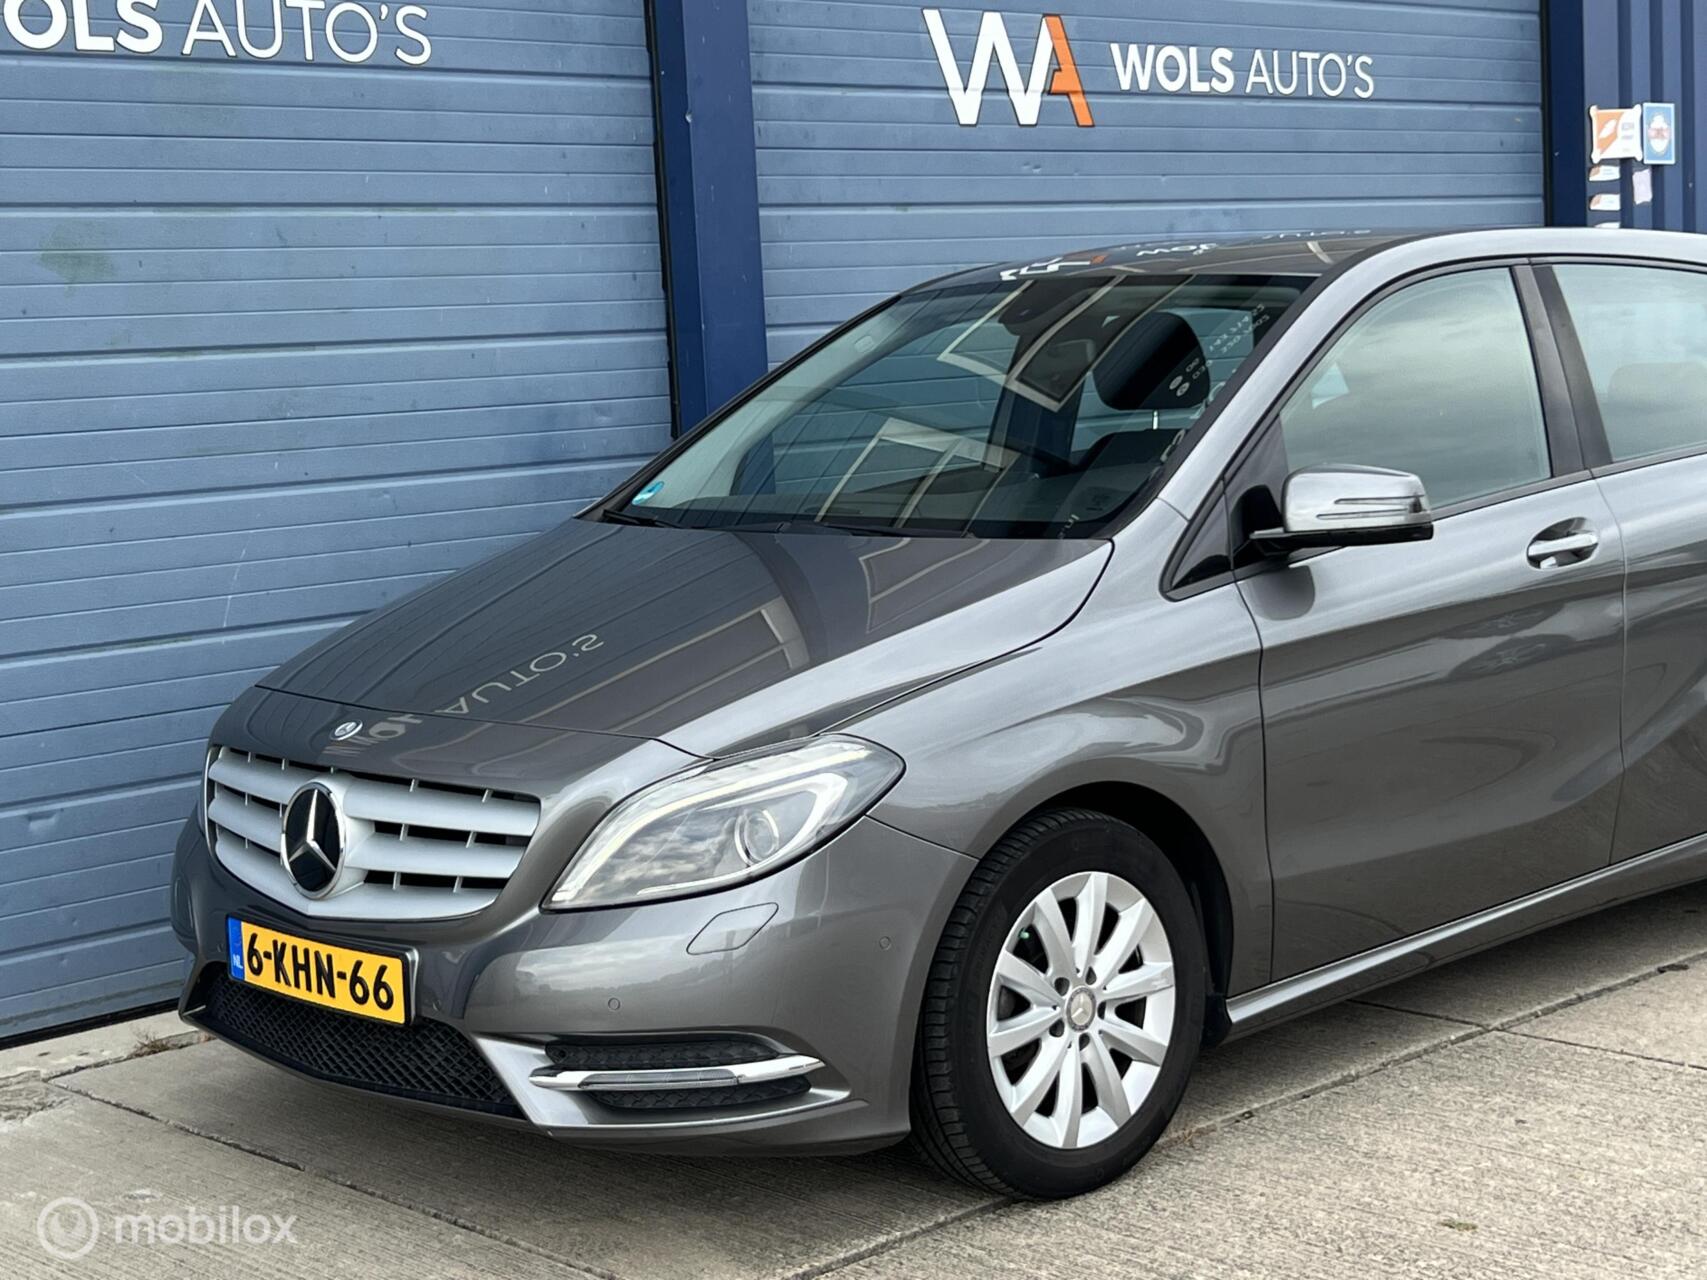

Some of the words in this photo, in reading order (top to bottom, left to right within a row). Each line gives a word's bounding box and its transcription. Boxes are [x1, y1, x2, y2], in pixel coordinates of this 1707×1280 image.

[181, 0, 432, 65] AUTO'S
[1110, 42, 1235, 93] WOLS
[1244, 49, 1376, 100] AUTO'S
[247, 933, 394, 1010] 6-KHN-66
